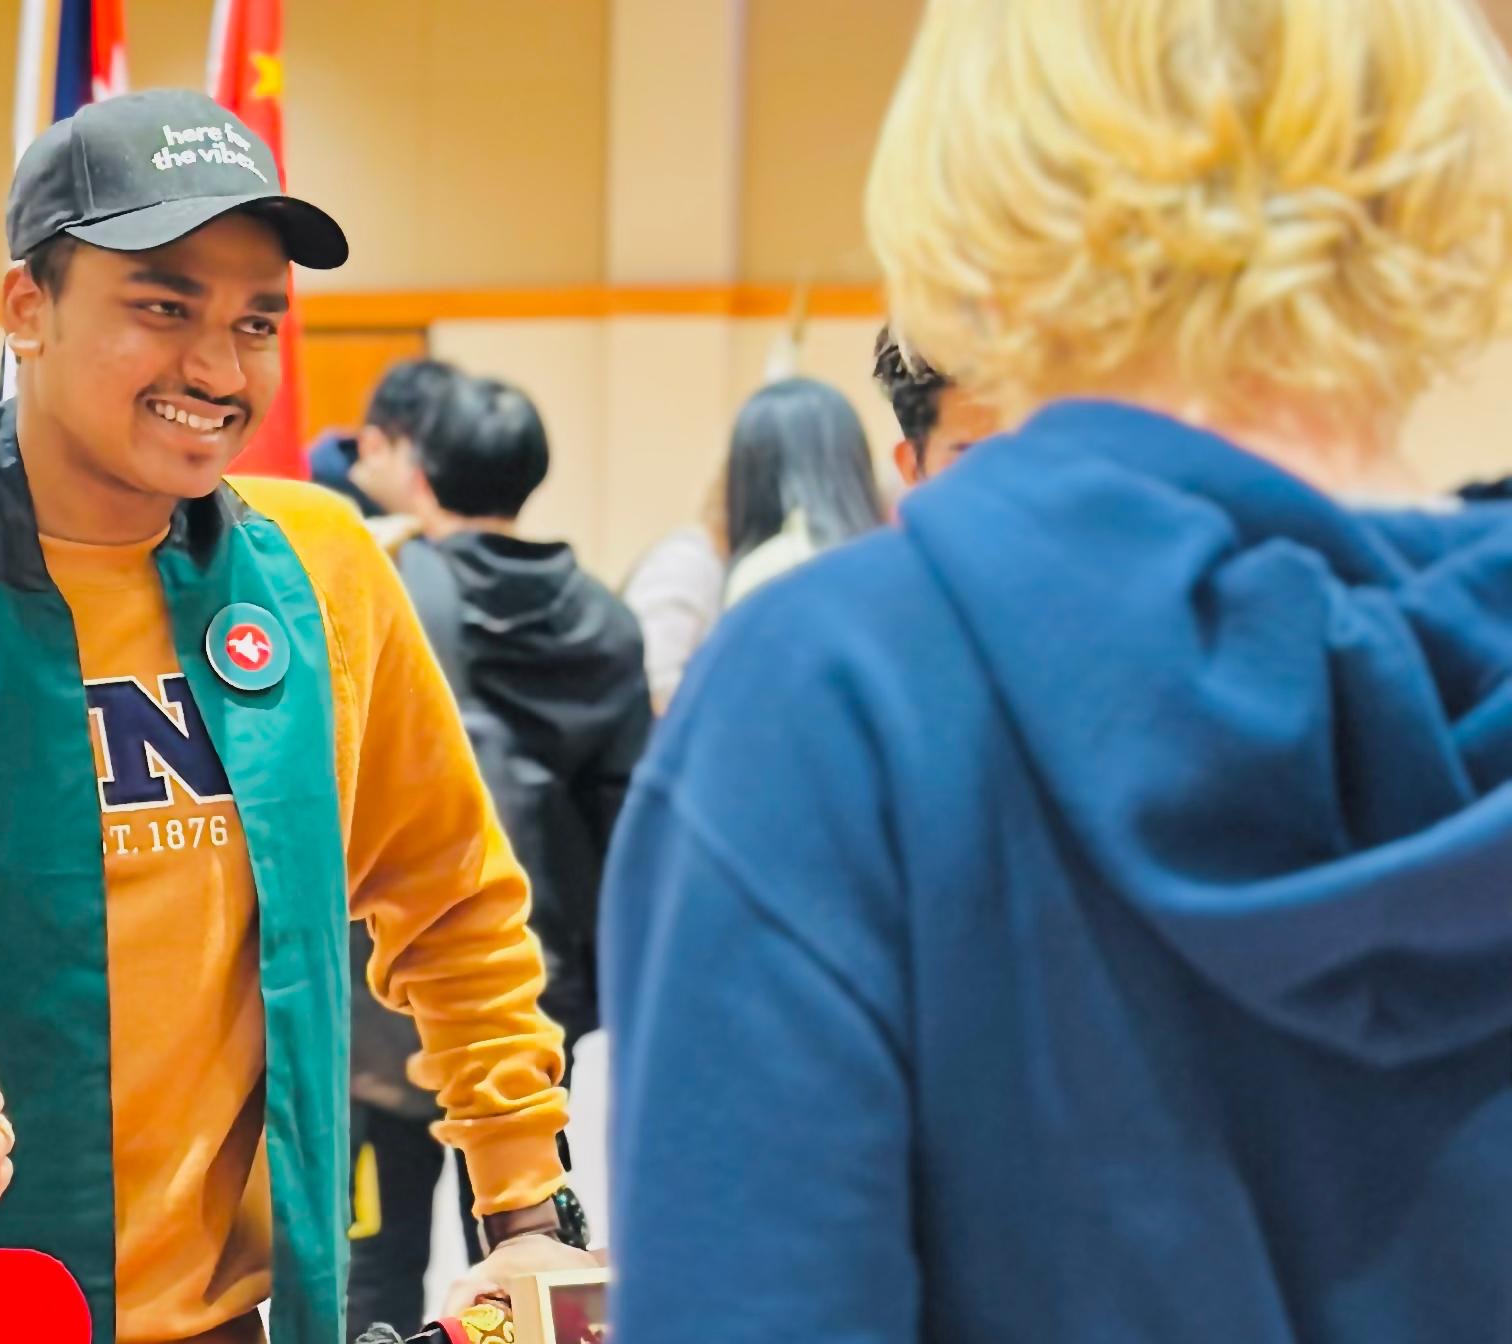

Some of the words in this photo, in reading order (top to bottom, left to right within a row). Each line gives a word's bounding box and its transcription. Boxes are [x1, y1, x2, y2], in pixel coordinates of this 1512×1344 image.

[162, 124, 223, 146] here
[151, 146, 197, 171] the
[102, 824, 139, 856] T.
[148, 815, 228, 853] 1876
